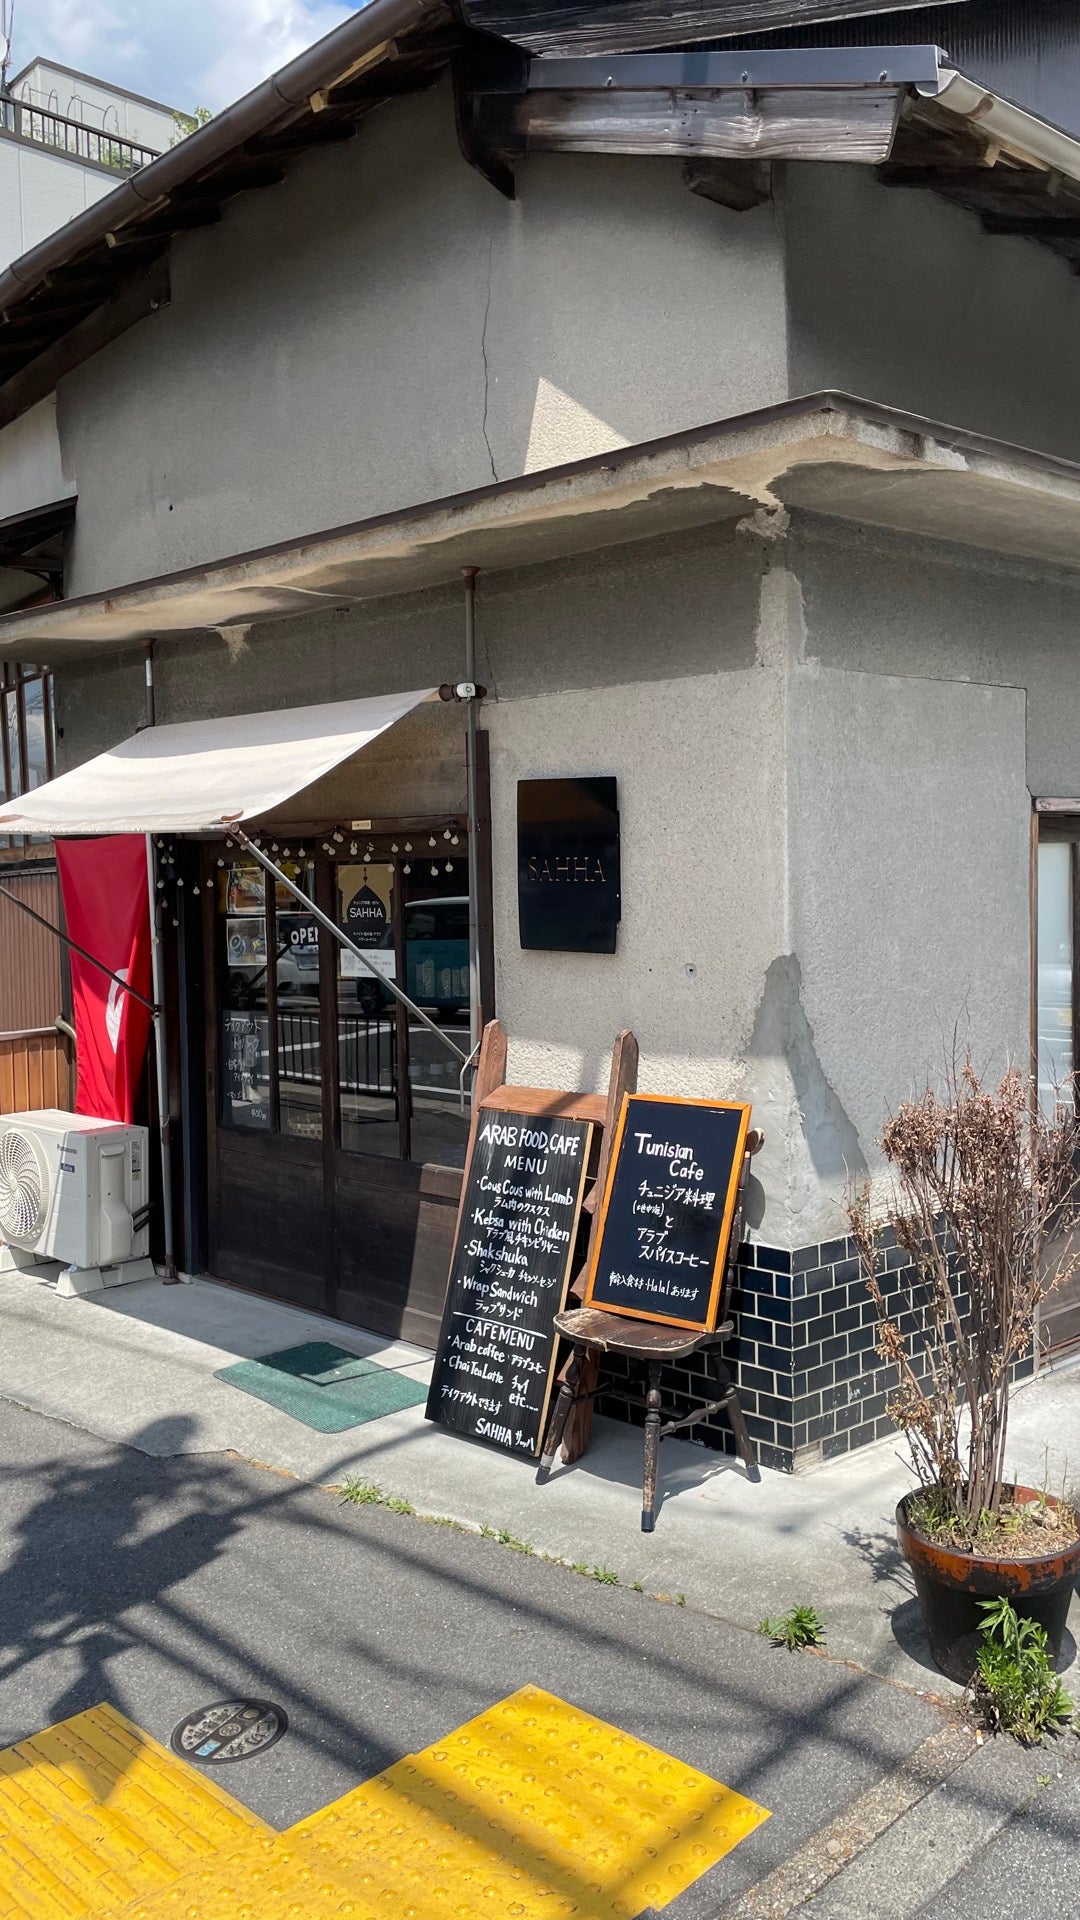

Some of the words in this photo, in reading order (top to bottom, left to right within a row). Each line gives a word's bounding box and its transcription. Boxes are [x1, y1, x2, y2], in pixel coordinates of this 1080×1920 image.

[527, 856, 607, 882] SAHHA
[349, 907, 384, 918] SAHHA
[479, 1123, 518, 1147] ARAB
[519, 1128, 548, 1150] FOOD
[550, 1133, 580, 1156] CAFE
[634, 1132, 694, 1160] Tunisian
[504, 1154, 548, 1175] MENU
[669, 1159, 704, 1181] Cafe
[480, 1175, 502, 1194] Cous
[502, 1179, 524, 1197] Cous
[525, 1184, 543, 1201] with
[544, 1184, 574, 1206] Lamb
[638, 1179, 716, 1210] チュニジア料理
[493, 1196, 551, 1217] ラム肉のクスクス
[473, 1207, 505, 1228] Kebsa
[508, 1216, 532, 1234] with
[533, 1217, 570, 1242] Chicken
[665, 1215, 674, 1228] と
[637, 1227, 669, 1245] アラブ
[467, 1239, 528, 1267] Shakshuka
[638, 1245, 710, 1268] スパイスコーヒー
[463, 1275, 490, 1298] Wrap
[489, 1281, 538, 1308] Sandwich
[475, 1299, 523, 1321] ラップサンド
[451, 1334, 477, 1353] Arab
[477, 1342, 506, 1363] coffee
[465, 1318, 499, 1340] CAFE
[498, 1326, 535, 1351] MENU
[448, 1354, 470, 1372] Chai
[470, 1360, 482, 1376] Tea
[482, 1363, 504, 1384] Latte
[475, 1417, 512, 1446] SAHHA
